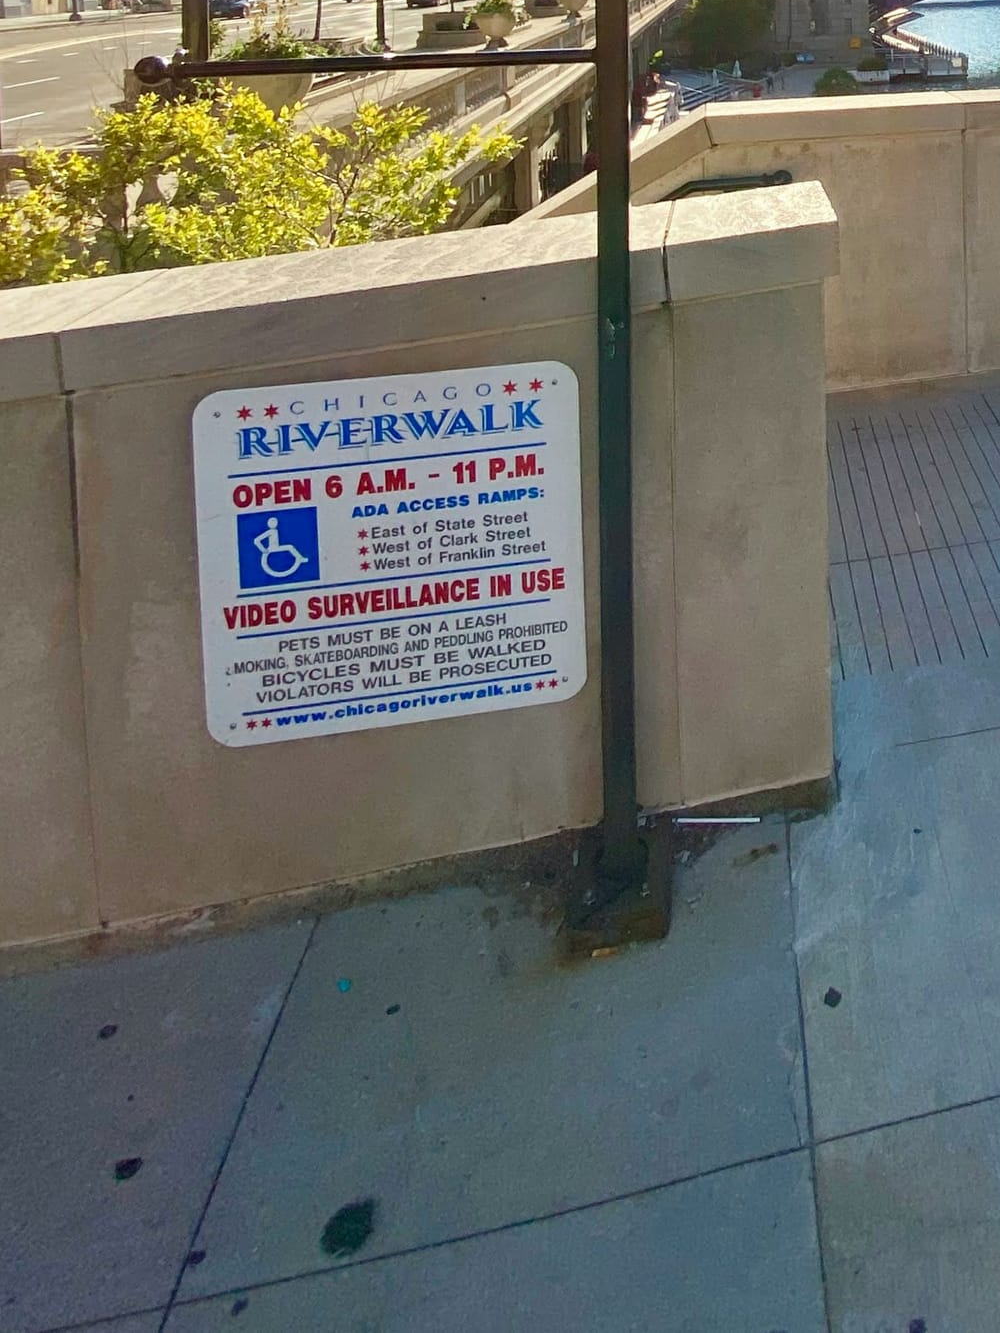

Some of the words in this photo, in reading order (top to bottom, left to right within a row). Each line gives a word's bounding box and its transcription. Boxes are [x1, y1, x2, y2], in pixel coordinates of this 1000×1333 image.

[289, 383, 492, 415] CHICAGO
[236, 399, 545, 460] RIVERWALK
[232, 478, 312, 508] OPEN
[325, 475, 344, 499] 6
[356, 468, 416, 496] A.M.
[452, 460, 477, 484] 11
[489, 454, 545, 480] P.M.
[352, 504, 389, 518] ADA
[397, 495, 470, 514] ACCESS
[478, 487, 545, 505] RAMPS:
[371, 525, 405, 539] East
[412, 522, 428, 535] of
[435, 518, 476, 532] State
[483, 511, 528, 527] Street
[372, 540, 410, 555] West
[417, 537, 433, 550] of
[439, 533, 479, 548] Clark
[485, 526, 531, 542] Street
[373, 556, 411, 571] West
[418, 552, 433, 566] of
[439, 544, 495, 564] Franklin
[502, 540, 546, 556] Street
[223, 600, 297, 630] VIDEO
[308, 578, 480, 620] SURVEILLANCE
[490, 574, 512, 597] IN
[521, 568, 566, 594] USE
[278, 636, 320, 653] PETS
[327, 629, 374, 647] MUST
[380, 626, 401, 640] BE
[408, 623, 432, 636] ON
[438, 621, 449, 632] A
[455, 613, 507, 630] LEASH
[294, 643, 399, 668] SKATEBOARDING
[404, 639, 430, 653] AND
[434, 630, 494, 649] PEDDLING
[498, 620, 568, 640] PROHIBITED
[256, 680, 354, 704] VIOLATORS
[362, 674, 402, 690] WILL
[409, 669, 432, 684] BE
[439, 653, 552, 680] PROSECUTED
[262, 663, 360, 687] BICYCLES
[370, 655, 425, 674] MUST
[434, 650, 459, 664] BE
[468, 639, 546, 660] WALKED
[276, 681, 533, 727] www.chicagoriverwalk.us
